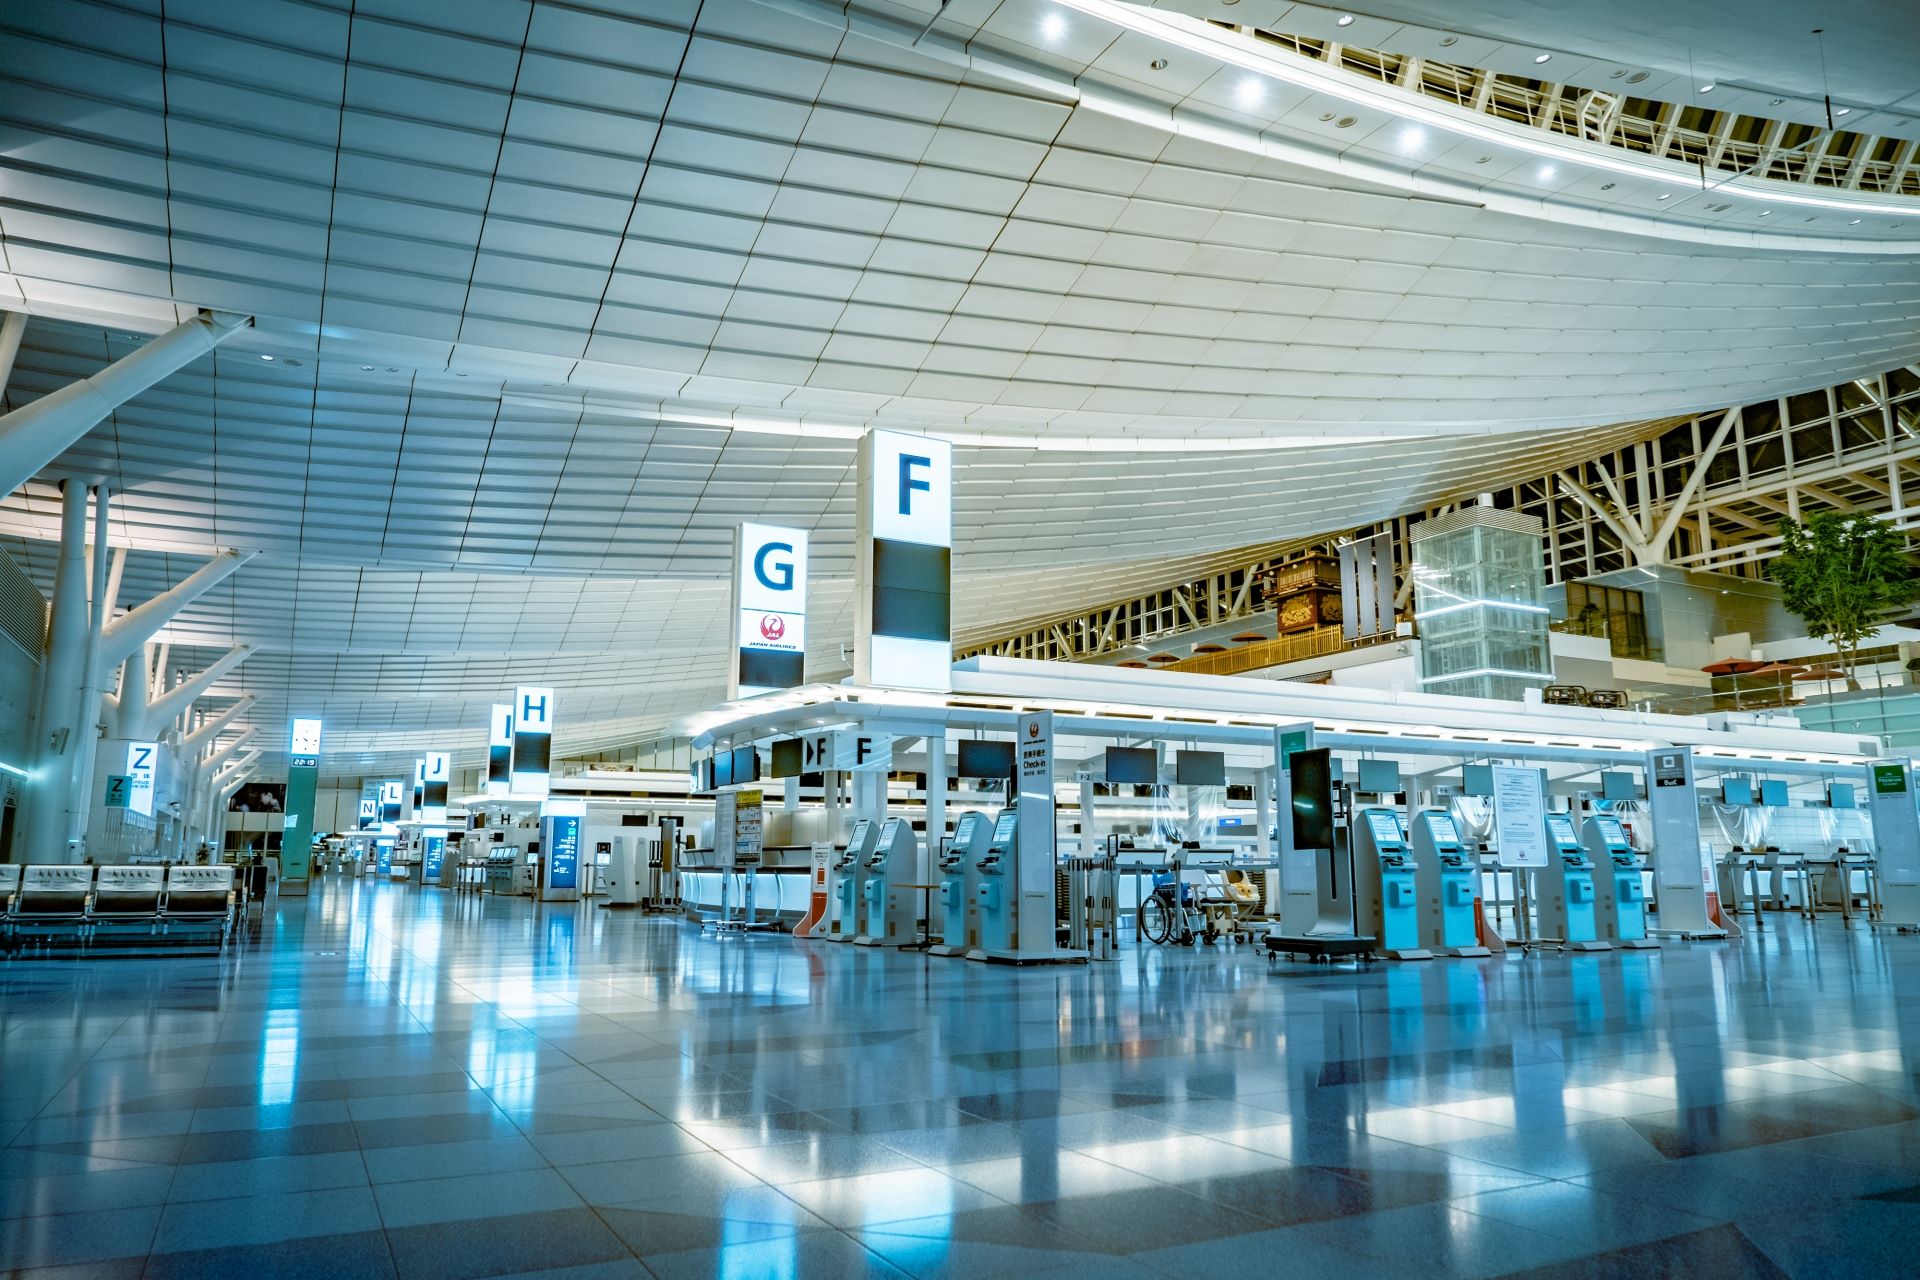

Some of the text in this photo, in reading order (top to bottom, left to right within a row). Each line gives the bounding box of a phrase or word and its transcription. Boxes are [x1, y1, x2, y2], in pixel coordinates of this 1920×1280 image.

[899, 453, 931, 516] F
[754, 542, 794, 591] G
[523, 694, 547, 722] H
[133, 747, 152, 770] Z
[817, 738, 826, 765] F
[857, 738, 871, 764] F
[432, 757, 442, 775] J
[1023, 759, 1046, 769] Check-in
[112, 778, 124, 792] Z
[390, 786, 398, 799] L
[363, 803, 373, 813] N
[501, 813, 511, 825] H
